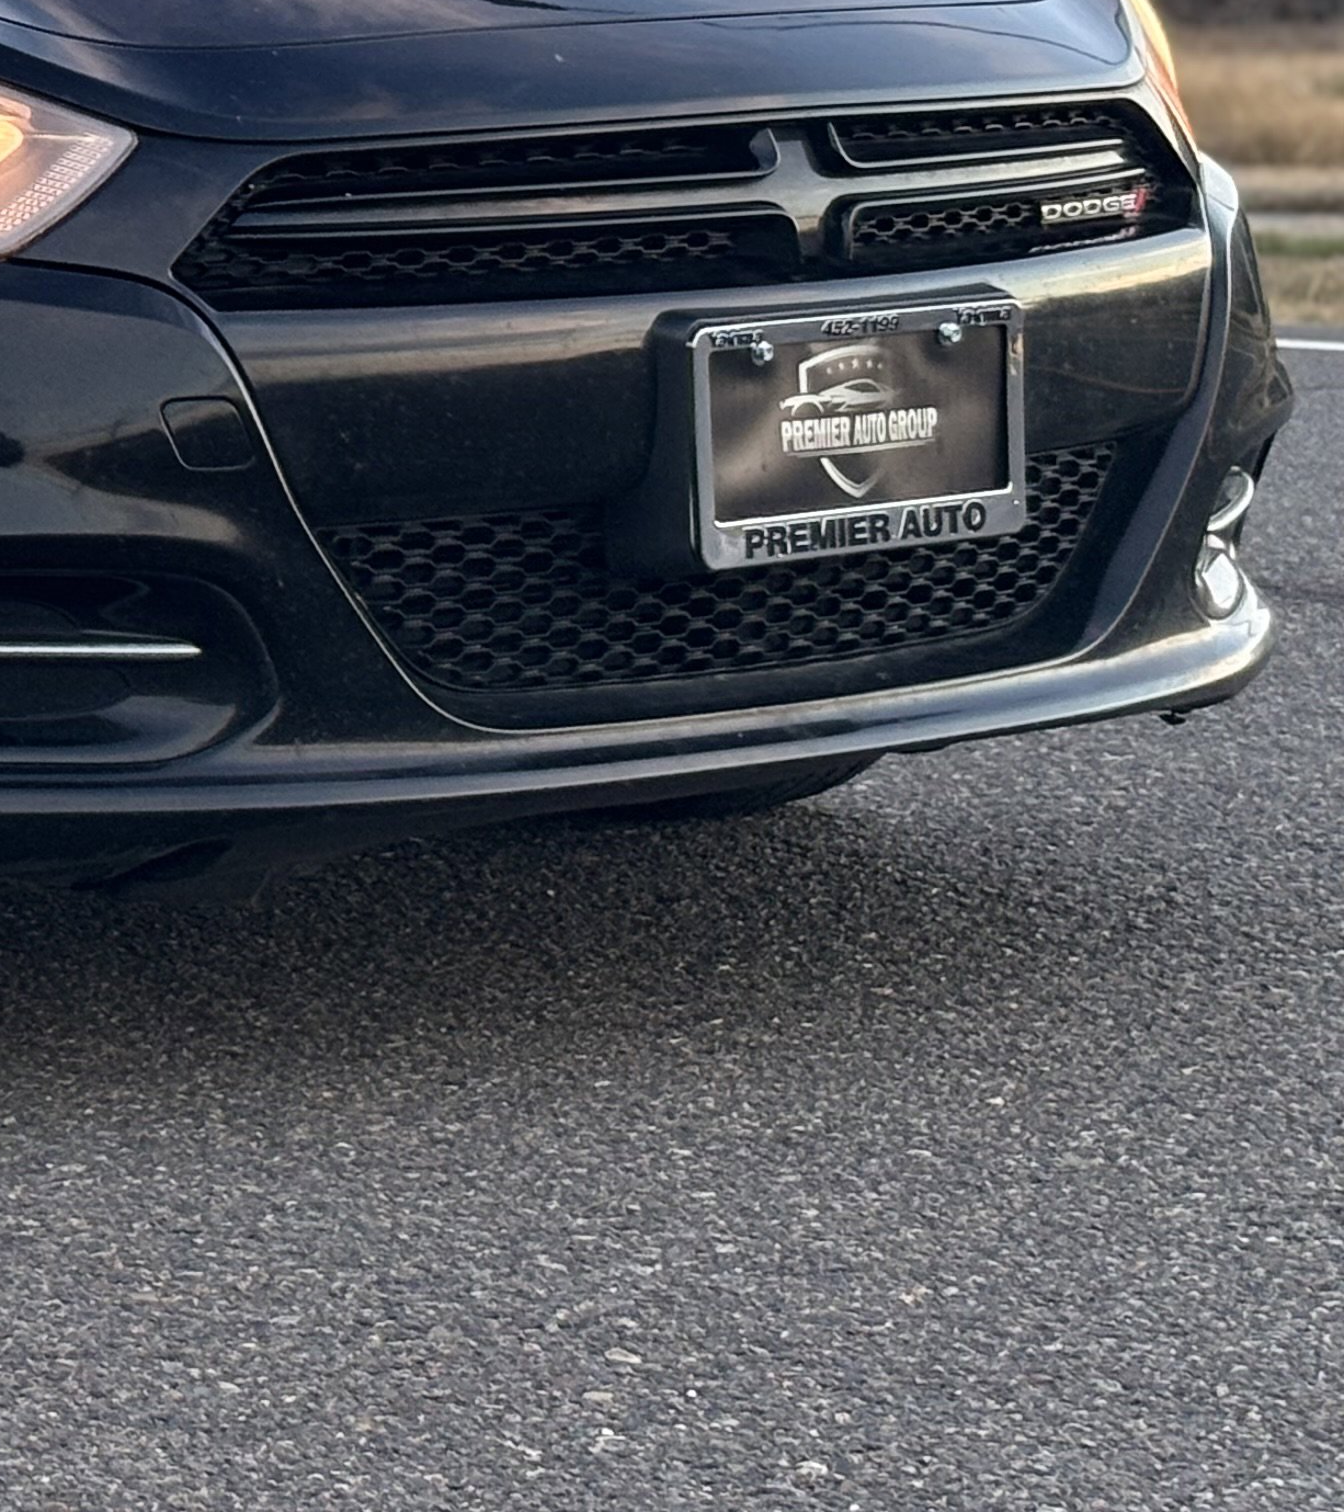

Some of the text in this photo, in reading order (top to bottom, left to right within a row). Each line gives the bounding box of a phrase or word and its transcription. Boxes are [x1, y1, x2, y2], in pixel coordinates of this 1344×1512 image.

[1040, 193, 1137, 220] DODGE
[781, 407, 938, 452] PREMIER AUTO GROUP
[743, 499, 987, 559] PREMIER AUTO
